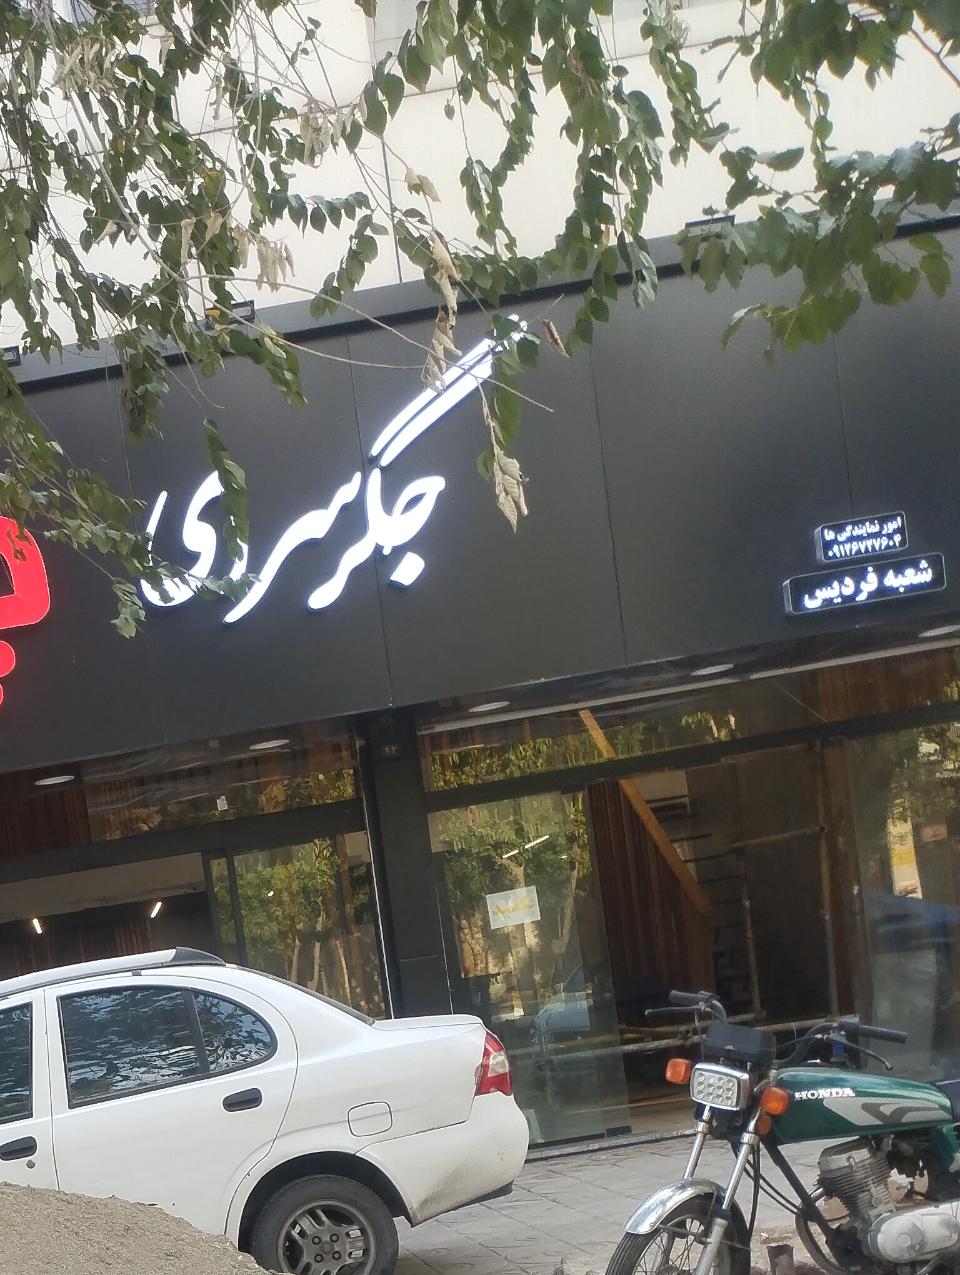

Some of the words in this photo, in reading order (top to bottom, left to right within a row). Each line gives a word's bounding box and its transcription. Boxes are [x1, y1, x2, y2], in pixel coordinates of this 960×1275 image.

[824, 528, 836, 541] ها
[837, 519, 880, 542] نمایندگی
[882, 516, 902, 535] امور
[883, 559, 933, 593] شعبه
[803, 566, 879, 609] فردیس
[794, 1087, 856, 1101] HONDA
